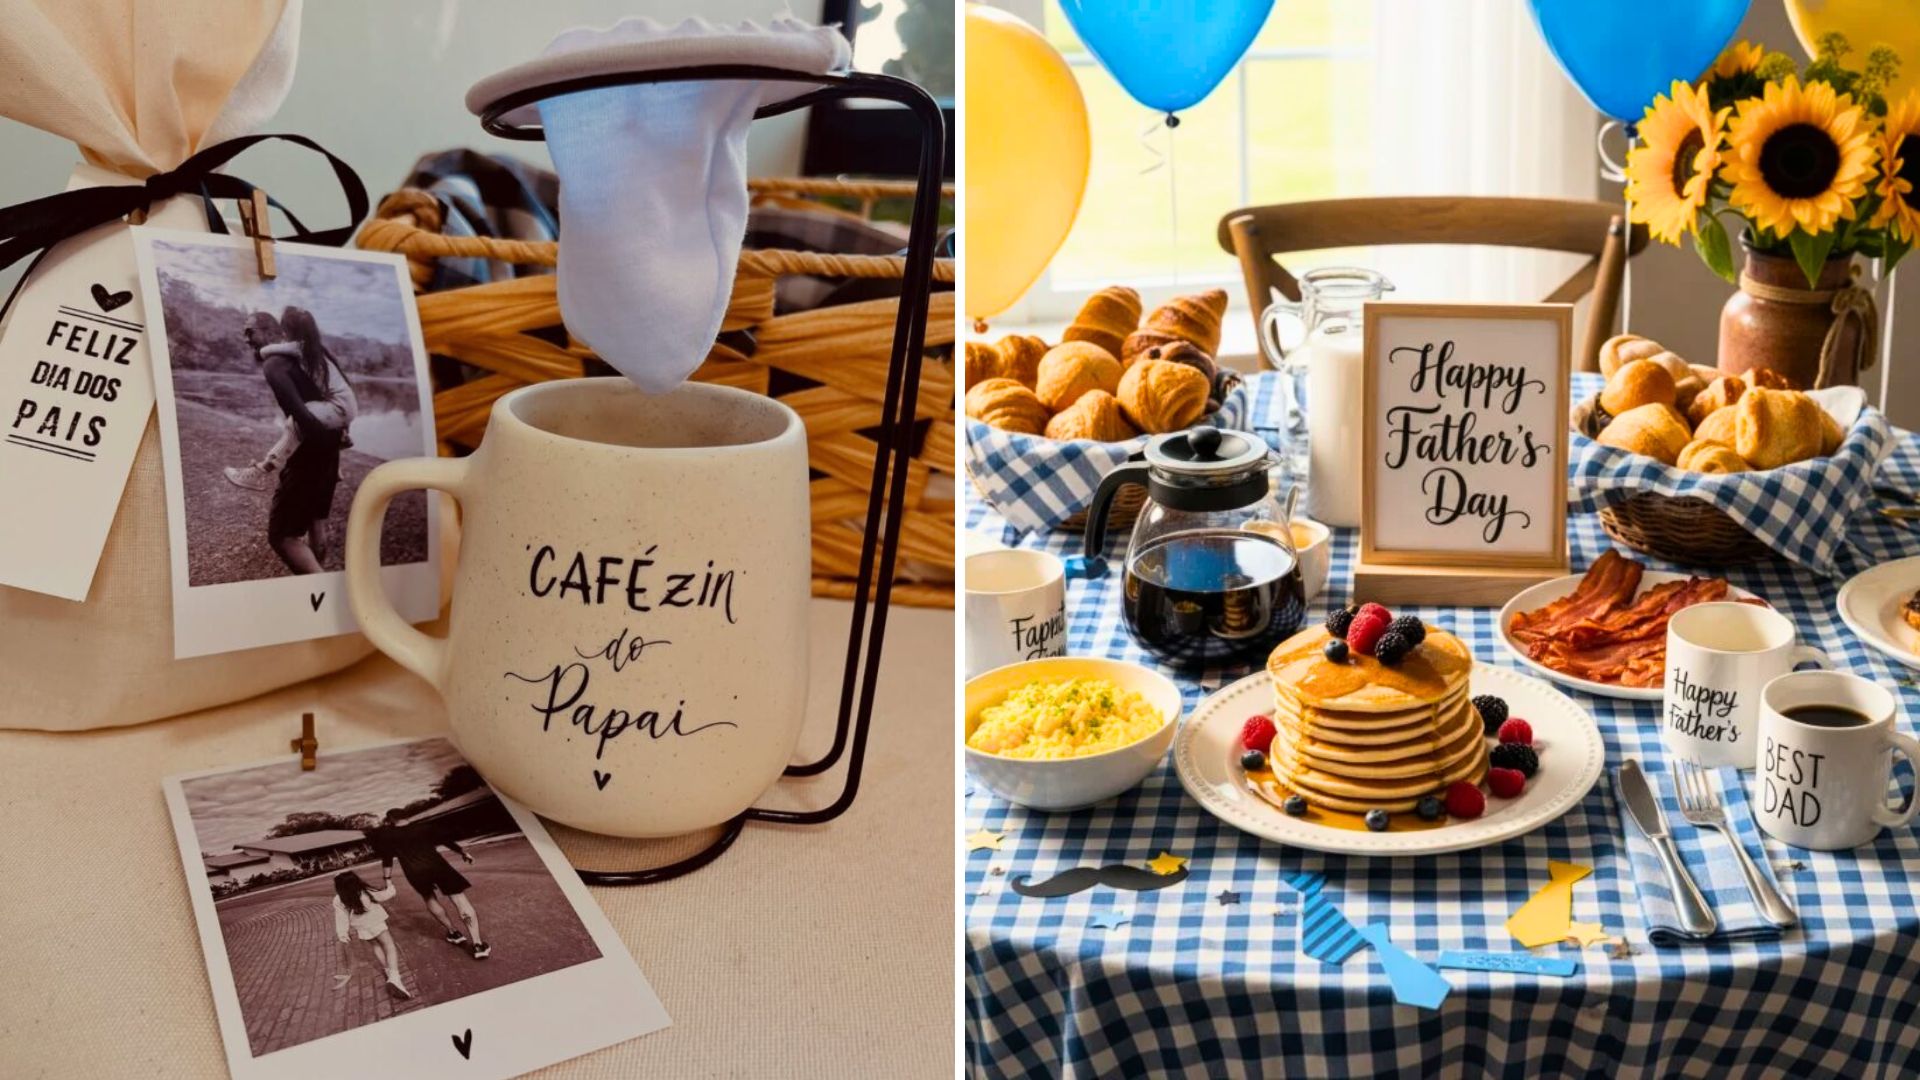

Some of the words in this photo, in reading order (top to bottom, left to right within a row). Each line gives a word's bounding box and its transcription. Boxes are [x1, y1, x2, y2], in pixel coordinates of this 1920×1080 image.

[46, 320, 138, 366] FELIZ
[30, 360, 72, 391] DIA
[73, 370, 122, 402] DOS
[1388, 340, 1546, 415] Happy
[12, 398, 107, 447] PAIS
[1384, 403, 1551, 470] Father's
[1421, 466, 1531, 544] Day
[574, 627, 673, 673] do
[503, 662, 739, 761] Papai
[1673, 667, 1740, 718] Happy
[1669, 702, 1742, 743] Father's
[1764, 736, 1826, 789] BEST
[1763, 776, 1822, 828] DAD
